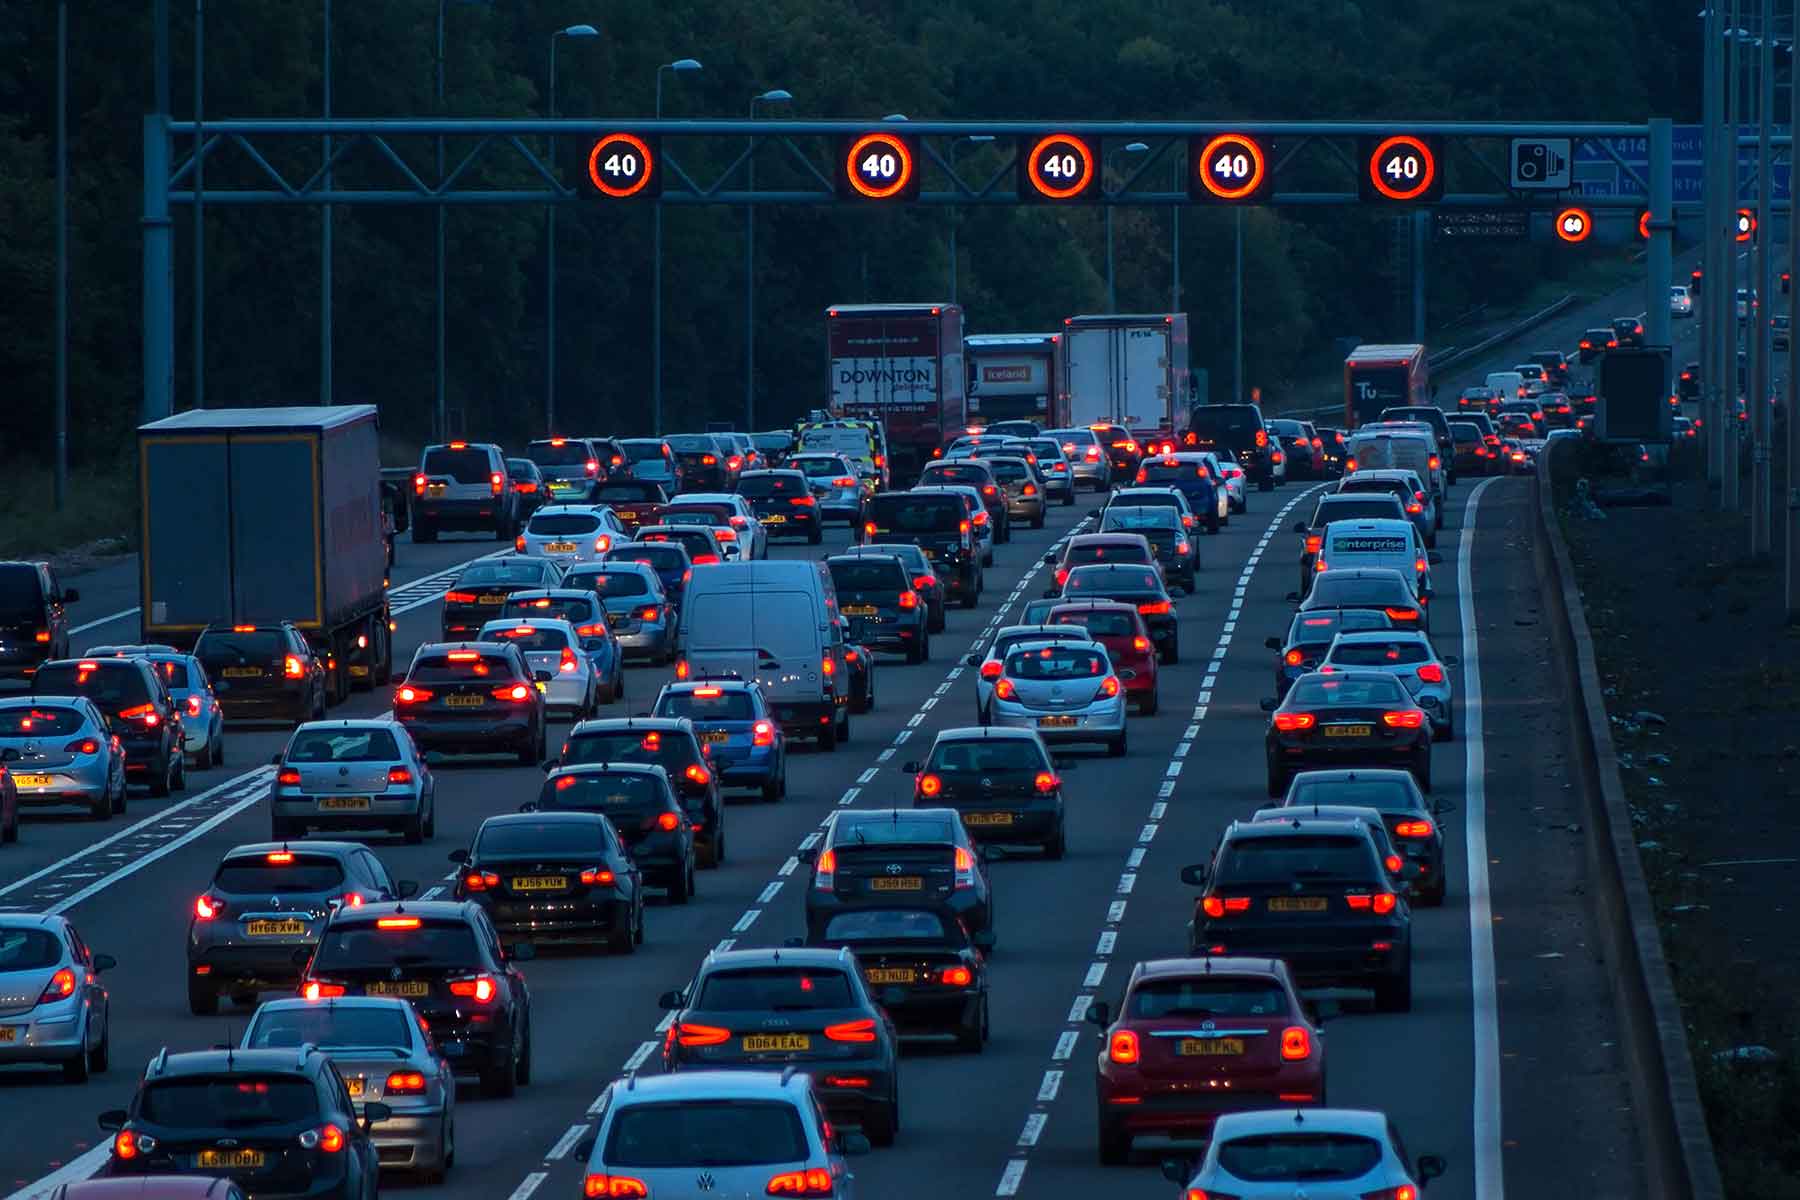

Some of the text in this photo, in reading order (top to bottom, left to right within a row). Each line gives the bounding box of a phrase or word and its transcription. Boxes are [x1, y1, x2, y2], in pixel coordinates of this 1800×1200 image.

[605, 154, 636, 176] 40
[863, 154, 895, 177] 40
[1045, 155, 1076, 177] 40
[1216, 155, 1248, 178] 40
[1386, 156, 1418, 179] 40
[1564, 217, 1582, 232] 60
[841, 369, 931, 384] DOWNTON
[988, 368, 1027, 381] Iceland
[1355, 382, 1377, 400] Tu
[1335, 539, 1404, 549] enterprise
